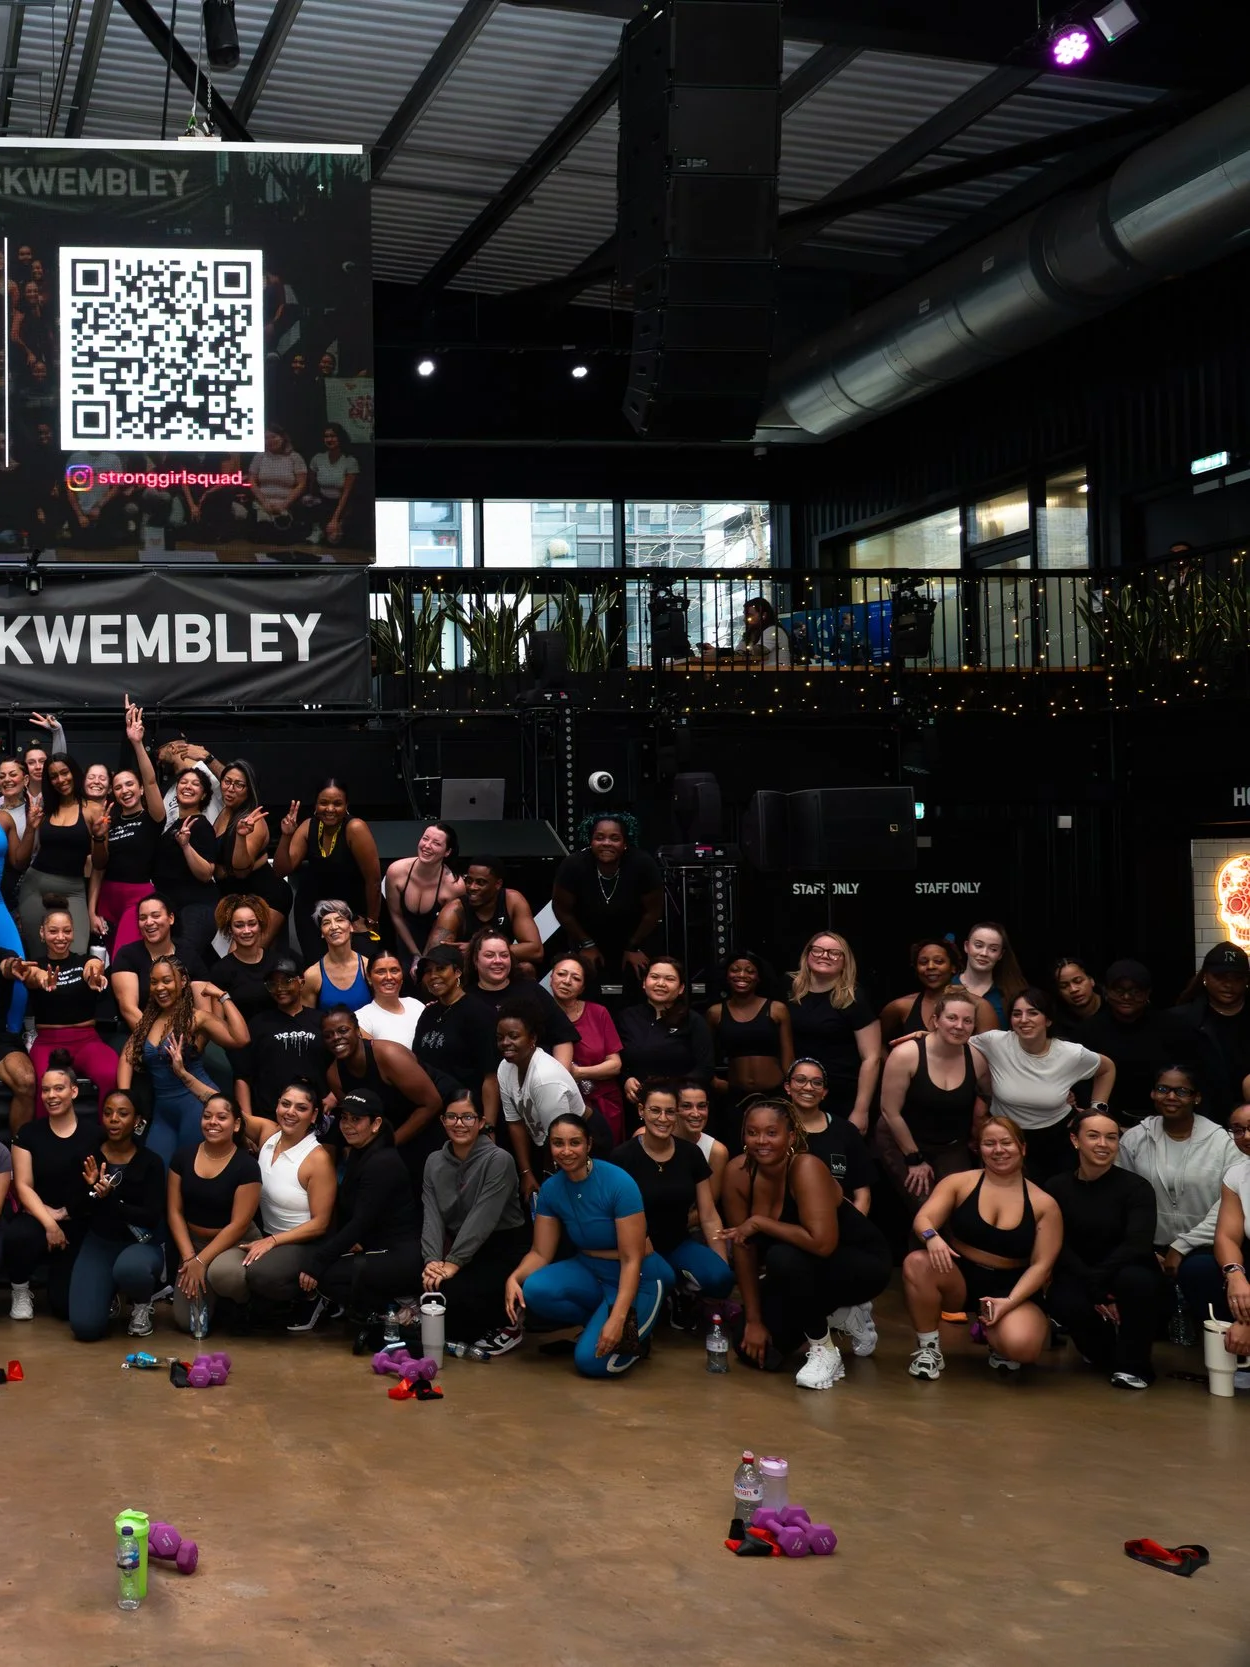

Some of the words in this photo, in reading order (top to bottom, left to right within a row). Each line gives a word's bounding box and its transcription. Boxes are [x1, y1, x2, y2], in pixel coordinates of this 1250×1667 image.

[98, 470, 252, 488] stronggirlsquad_
[1233, 786, 1250, 807] H
[914, 882, 950, 894] STAFF
[952, 882, 981, 894] ONLY
